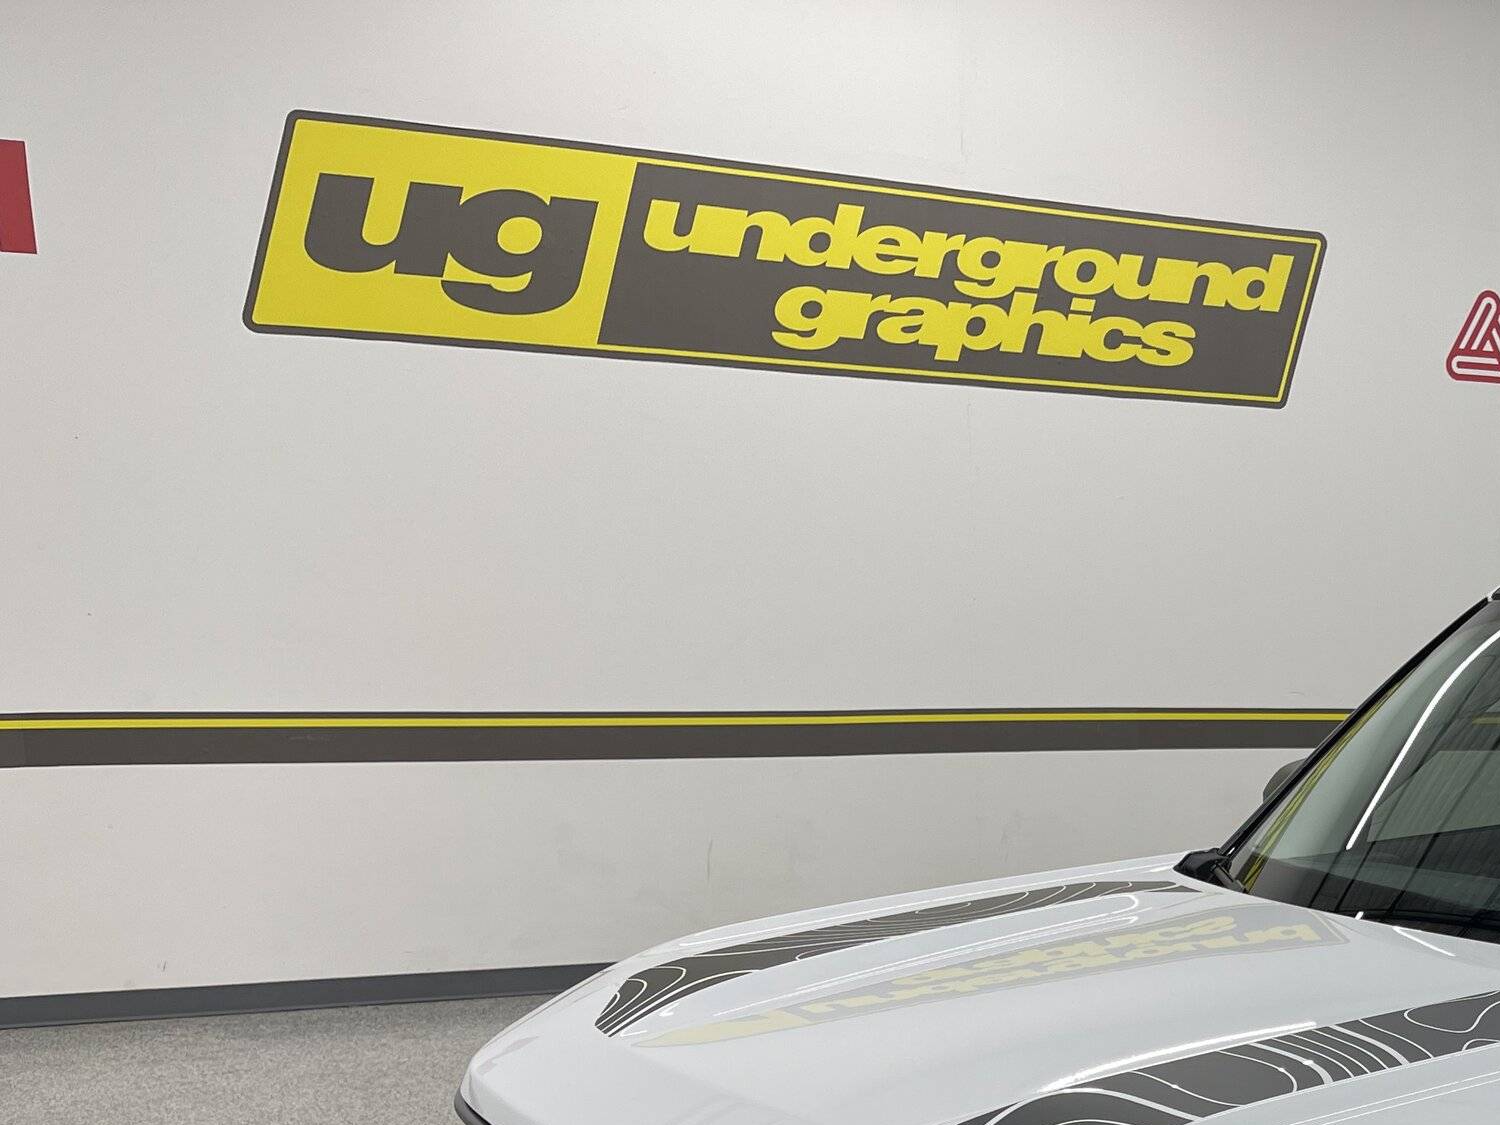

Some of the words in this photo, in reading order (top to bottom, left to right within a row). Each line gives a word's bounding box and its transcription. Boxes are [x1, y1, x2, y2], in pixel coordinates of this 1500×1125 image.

[303, 171, 598, 315] ug
[642, 198, 1290, 313] underground
[771, 285, 1194, 368] graphics
